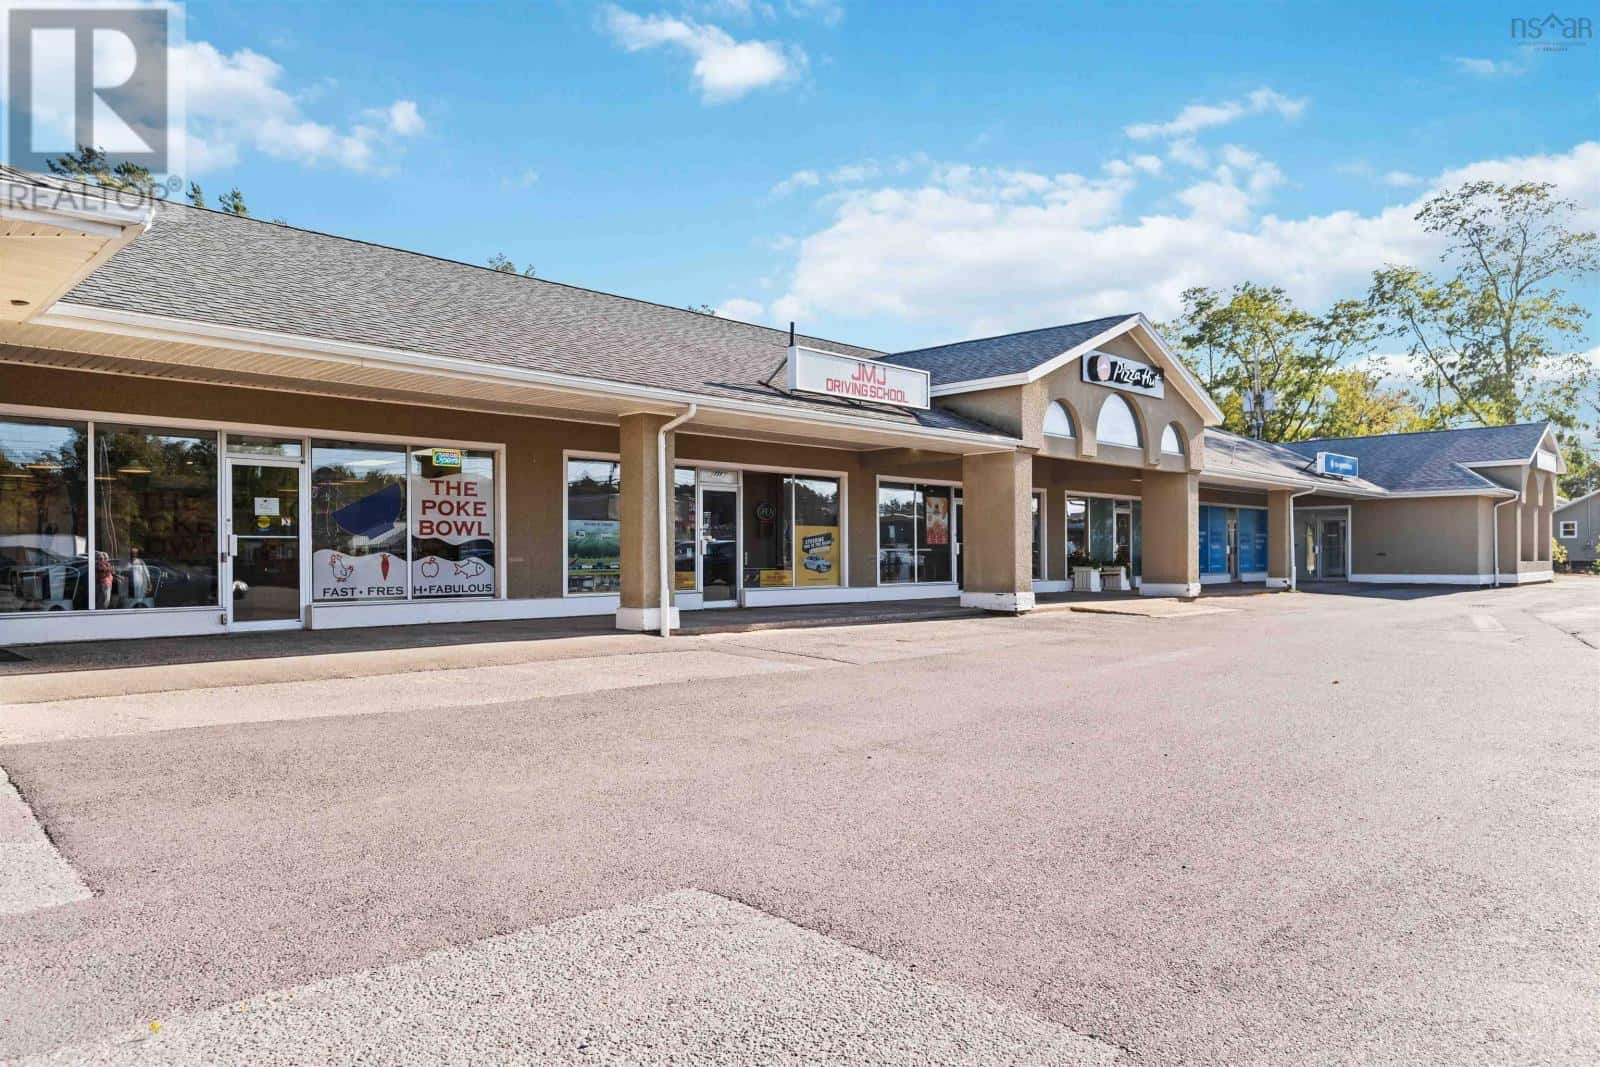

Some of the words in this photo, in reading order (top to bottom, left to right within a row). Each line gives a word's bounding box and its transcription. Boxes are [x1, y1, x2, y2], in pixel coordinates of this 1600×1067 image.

[851, 363, 887, 386] JMJ
[1113, 361, 1141, 383] Pizza
[1141, 367, 1161, 386] Hut
[826, 378, 869, 398] DRIVING
[869, 385, 909, 403] SCHOOL
[429, 480, 478, 497] THE
[421, 500, 487, 517] POKE
[418, 520, 490, 537] BOWL
[322, 587, 357, 597] FAST
